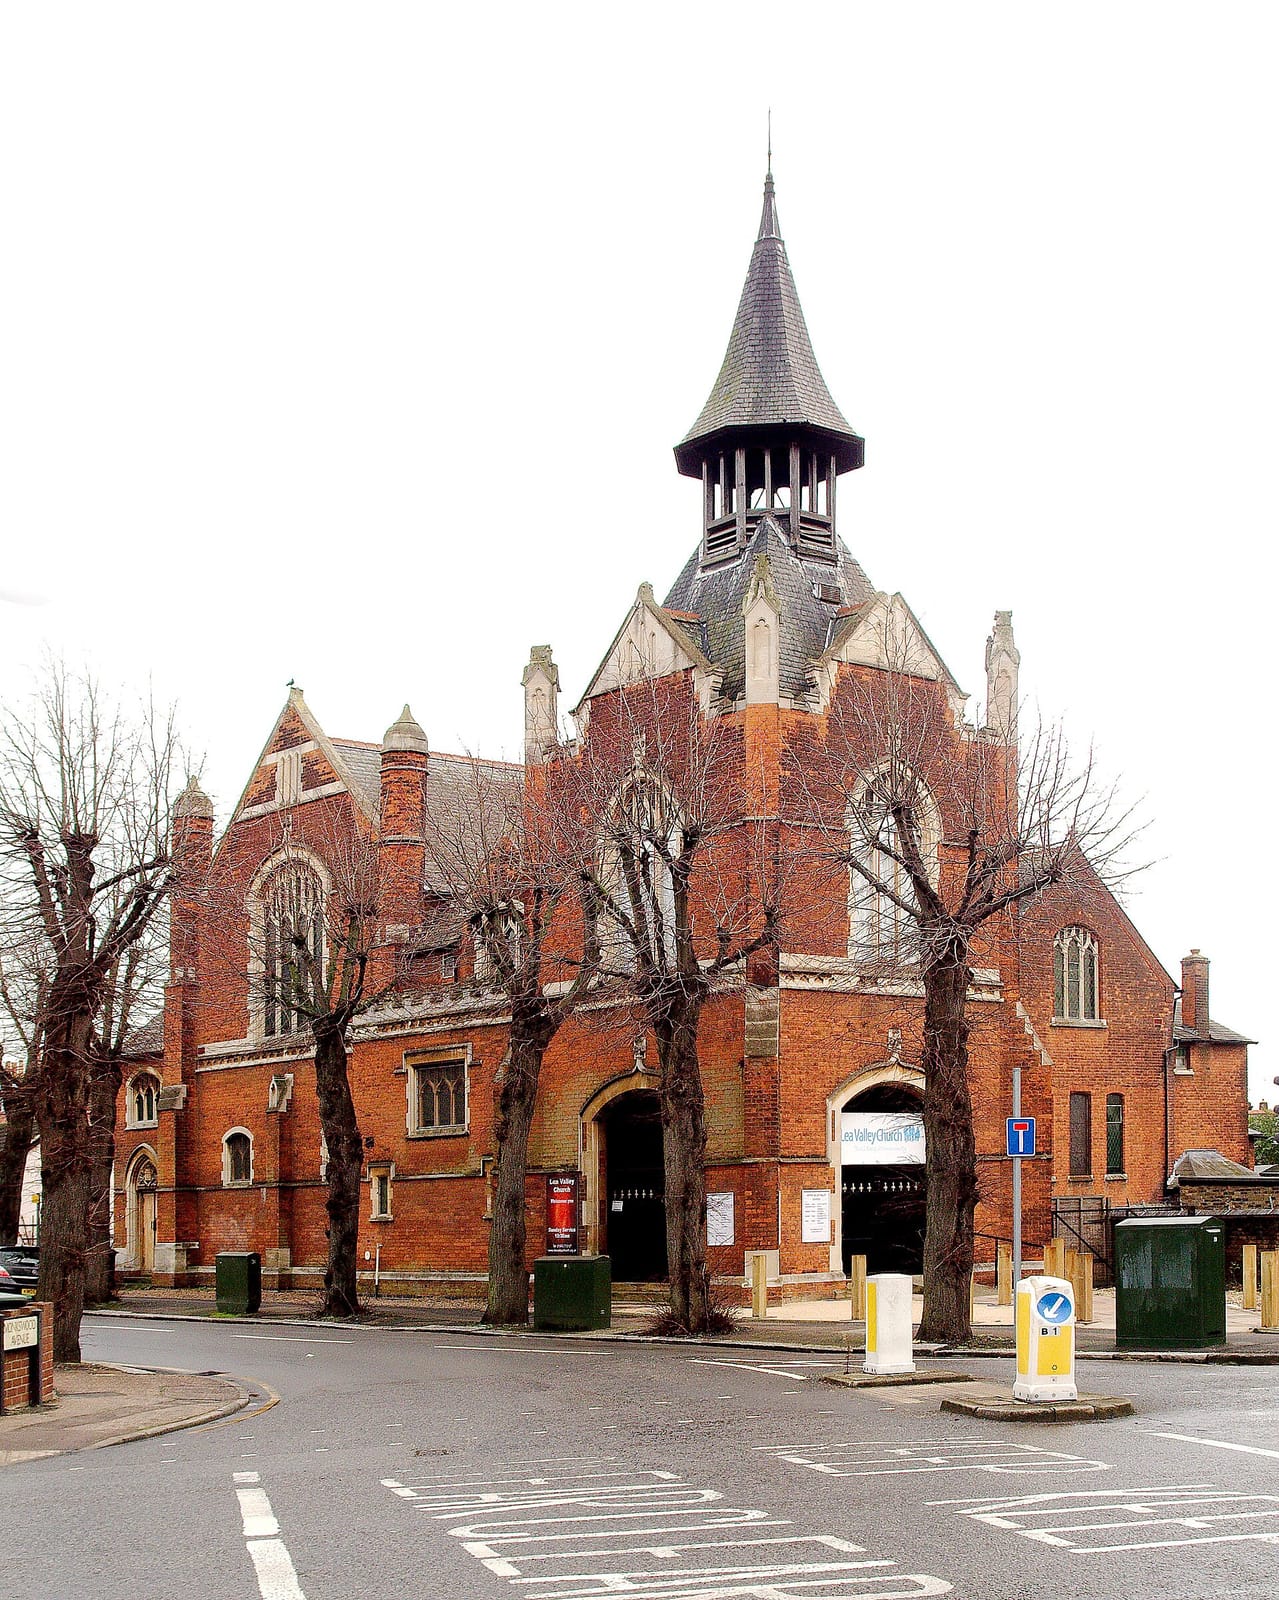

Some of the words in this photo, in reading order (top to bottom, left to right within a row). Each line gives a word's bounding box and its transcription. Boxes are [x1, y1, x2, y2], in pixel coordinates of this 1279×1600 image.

[854, 1128, 877, 1145] Valley
[877, 1128, 903, 1142] Church
[559, 1178, 575, 1186] Valley
[1041, 1327, 1049, 1336] B
[1052, 1327, 1058, 1336] 1
